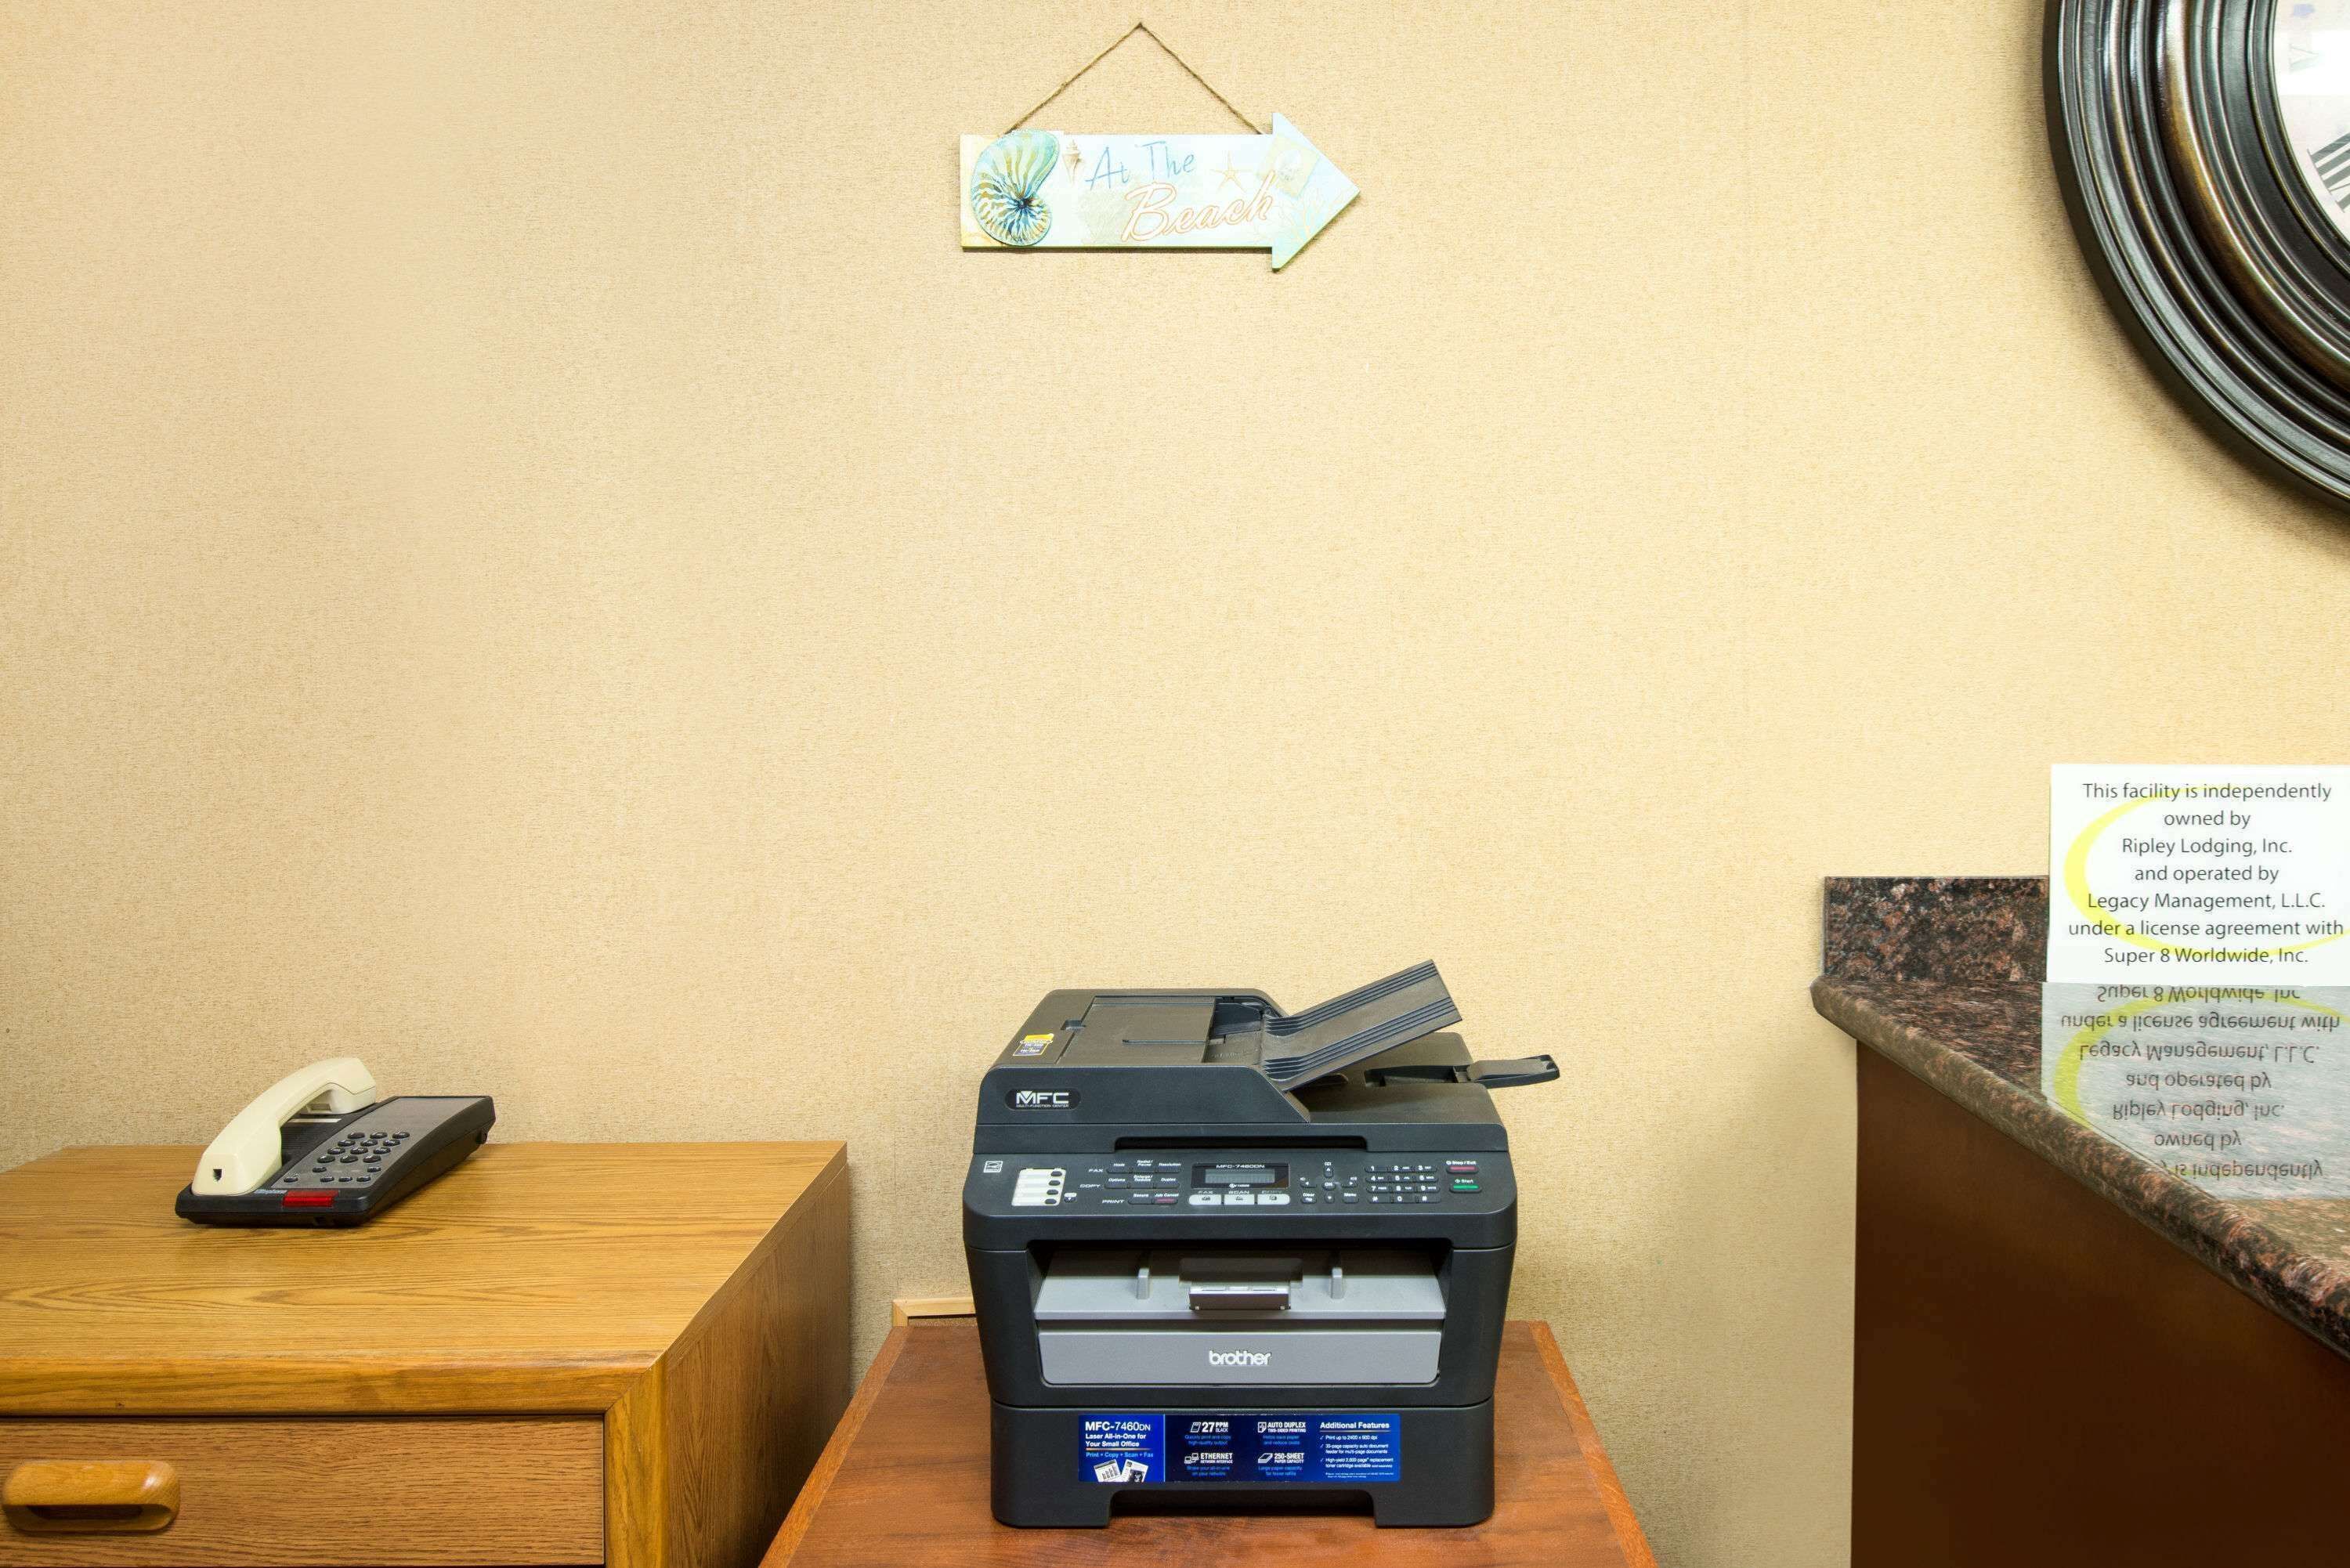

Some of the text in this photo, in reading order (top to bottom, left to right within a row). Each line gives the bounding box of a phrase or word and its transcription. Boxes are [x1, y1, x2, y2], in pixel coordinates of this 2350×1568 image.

[1086, 141, 1195, 191] At The
[1122, 171, 1278, 242] Beach
[2082, 782, 2331, 802] This facility is independently
[2164, 811, 2251, 829] owned by
[2123, 838, 2292, 857] Ripley Lodging, Inc.
[2135, 865, 2279, 884] and operated by
[2088, 893, 2325, 914] Legacy Management, L.L.C.
[2069, 920, 2344, 940] under a license agreement with
[2105, 948, 2308, 966] Super 8 Worldwide, Inc.
[1016, 1090, 1069, 1104] MFC
[1209, 1350, 1272, 1366] brother
[1085, 1421, 1151, 1432] MFC-7460DN
[1201, 1422, 1215, 1433] 27
